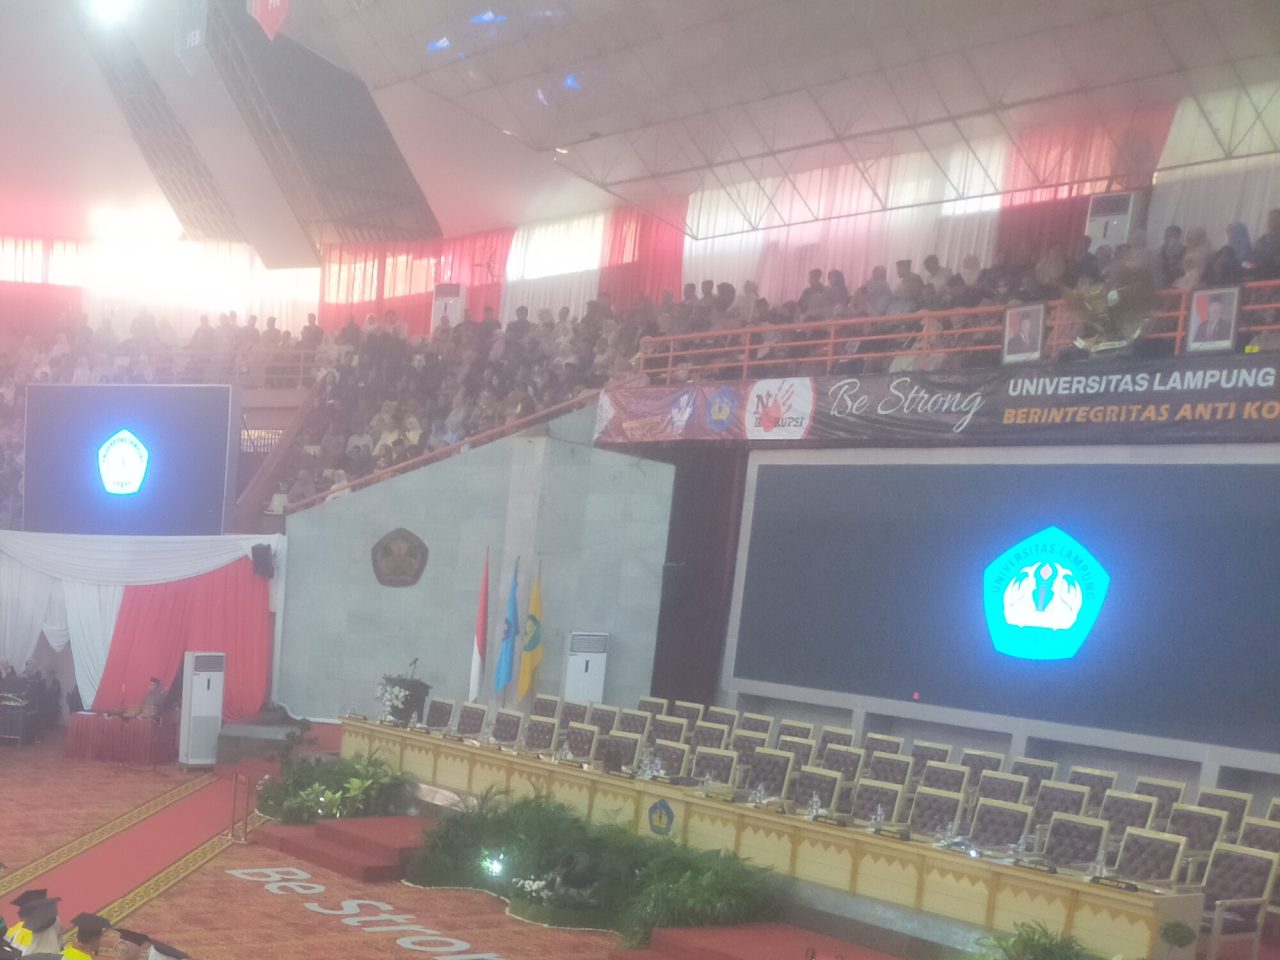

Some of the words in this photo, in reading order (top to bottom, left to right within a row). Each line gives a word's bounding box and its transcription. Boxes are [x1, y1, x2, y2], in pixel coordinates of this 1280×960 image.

[1007, 372, 1150, 397] UNIVERSITAS
[1152, 367, 1276, 392] LAMPUNG
[828, 378, 869, 417] Be
[877, 377, 985, 433] Strong
[1002, 404, 1170, 425] BERINTEGRITAS
[1174, 402, 1237, 421] ANTI
[1242, 401, 1280, 420] KO
[991, 543, 1056, 593] UNIVERSITAS
[225, 866, 326, 896] Be
